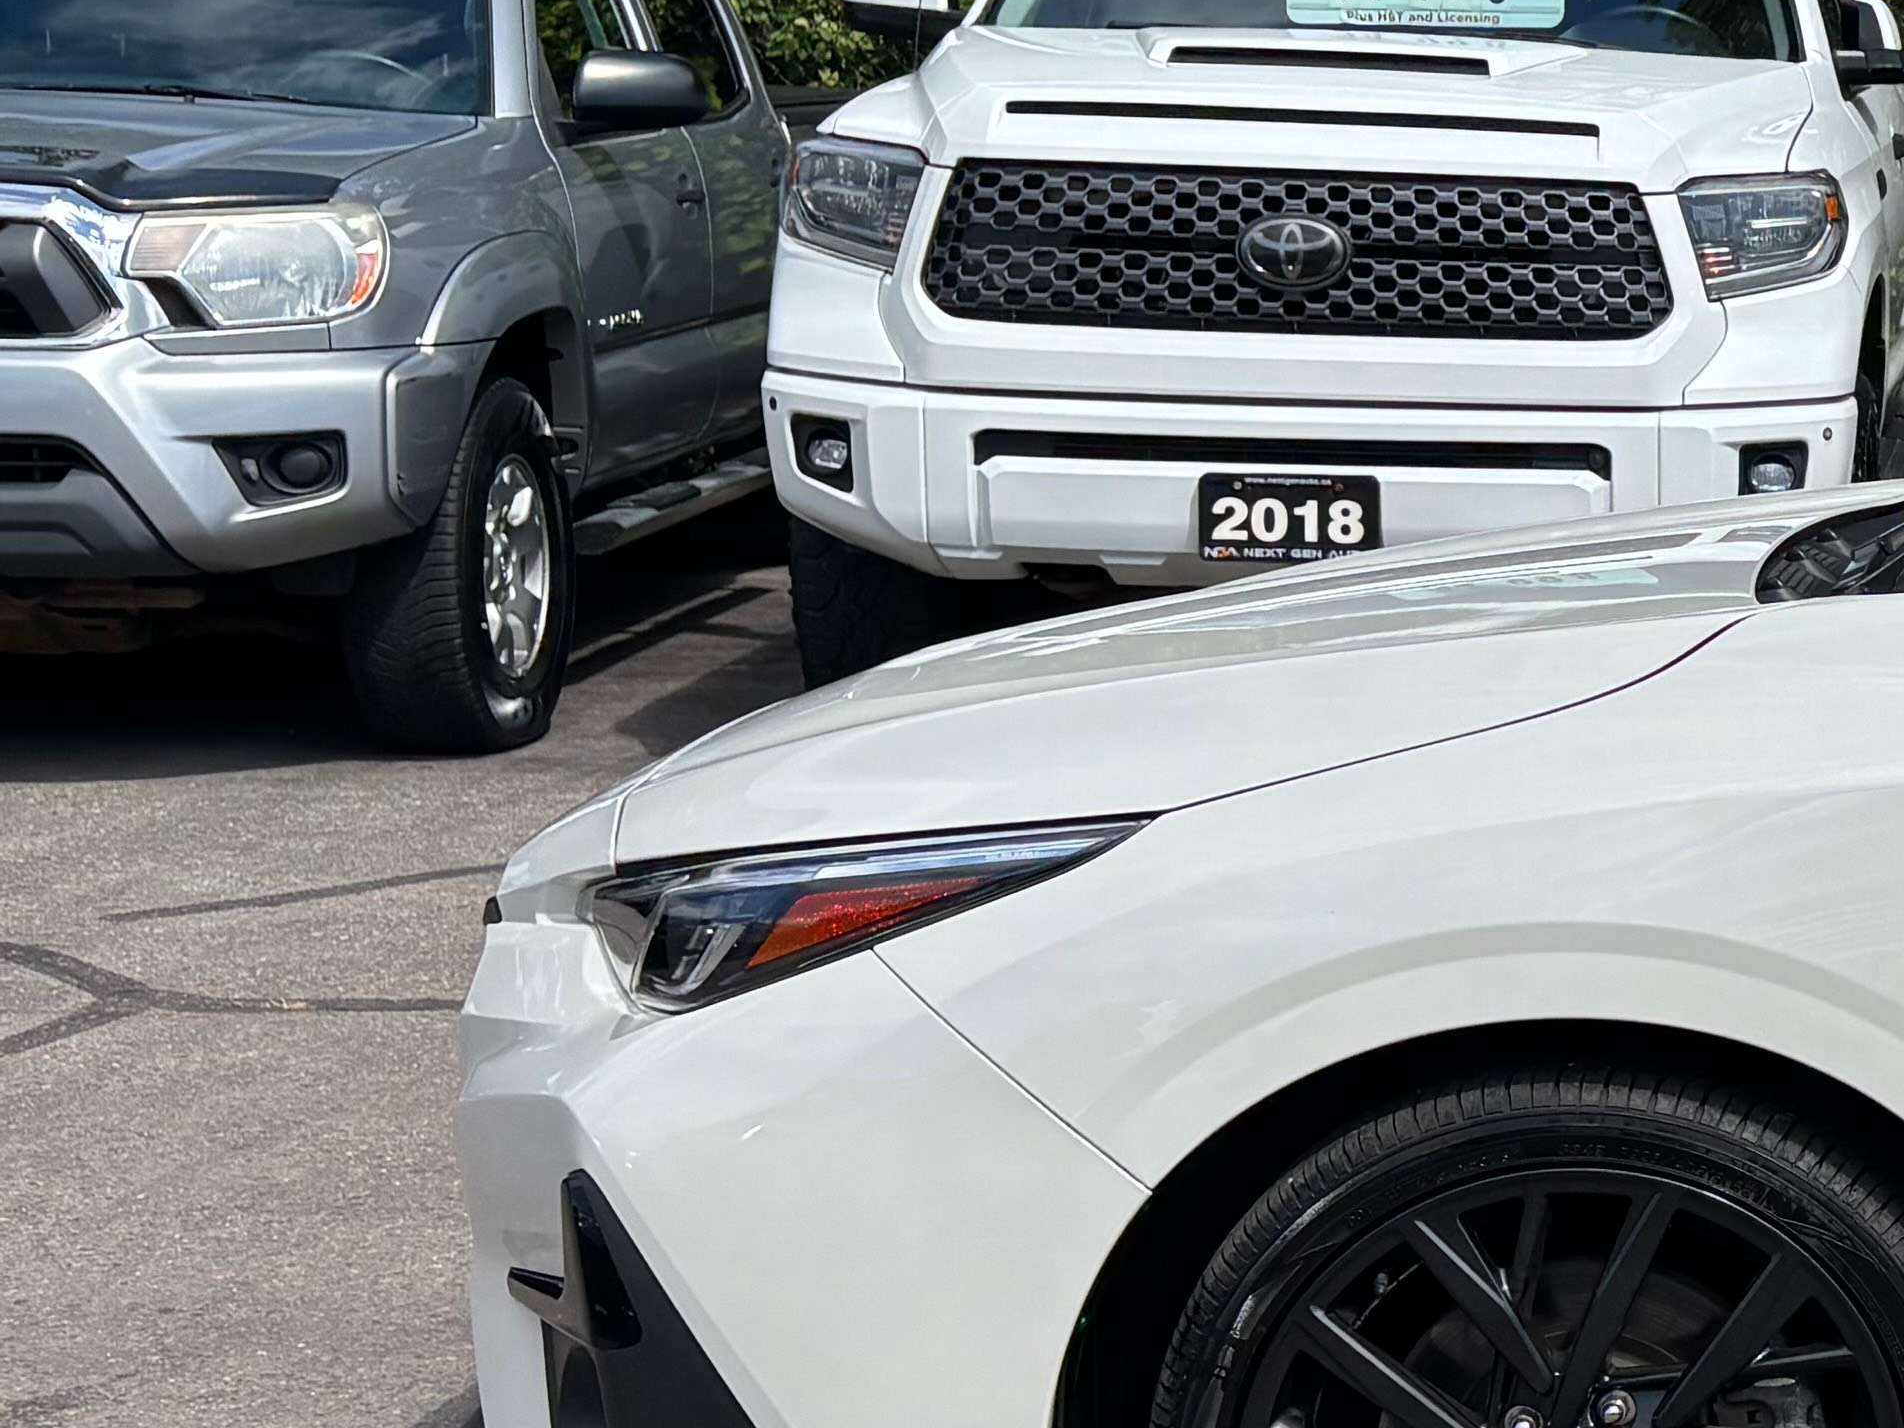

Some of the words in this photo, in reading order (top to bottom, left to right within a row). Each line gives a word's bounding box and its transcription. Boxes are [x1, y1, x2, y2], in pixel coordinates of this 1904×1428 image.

[1408, 11, 1434, 23] and
[1211, 496, 1366, 545] 2018
[1243, 547, 1286, 559] NEXT
[1290, 548, 1323, 560] GEN
